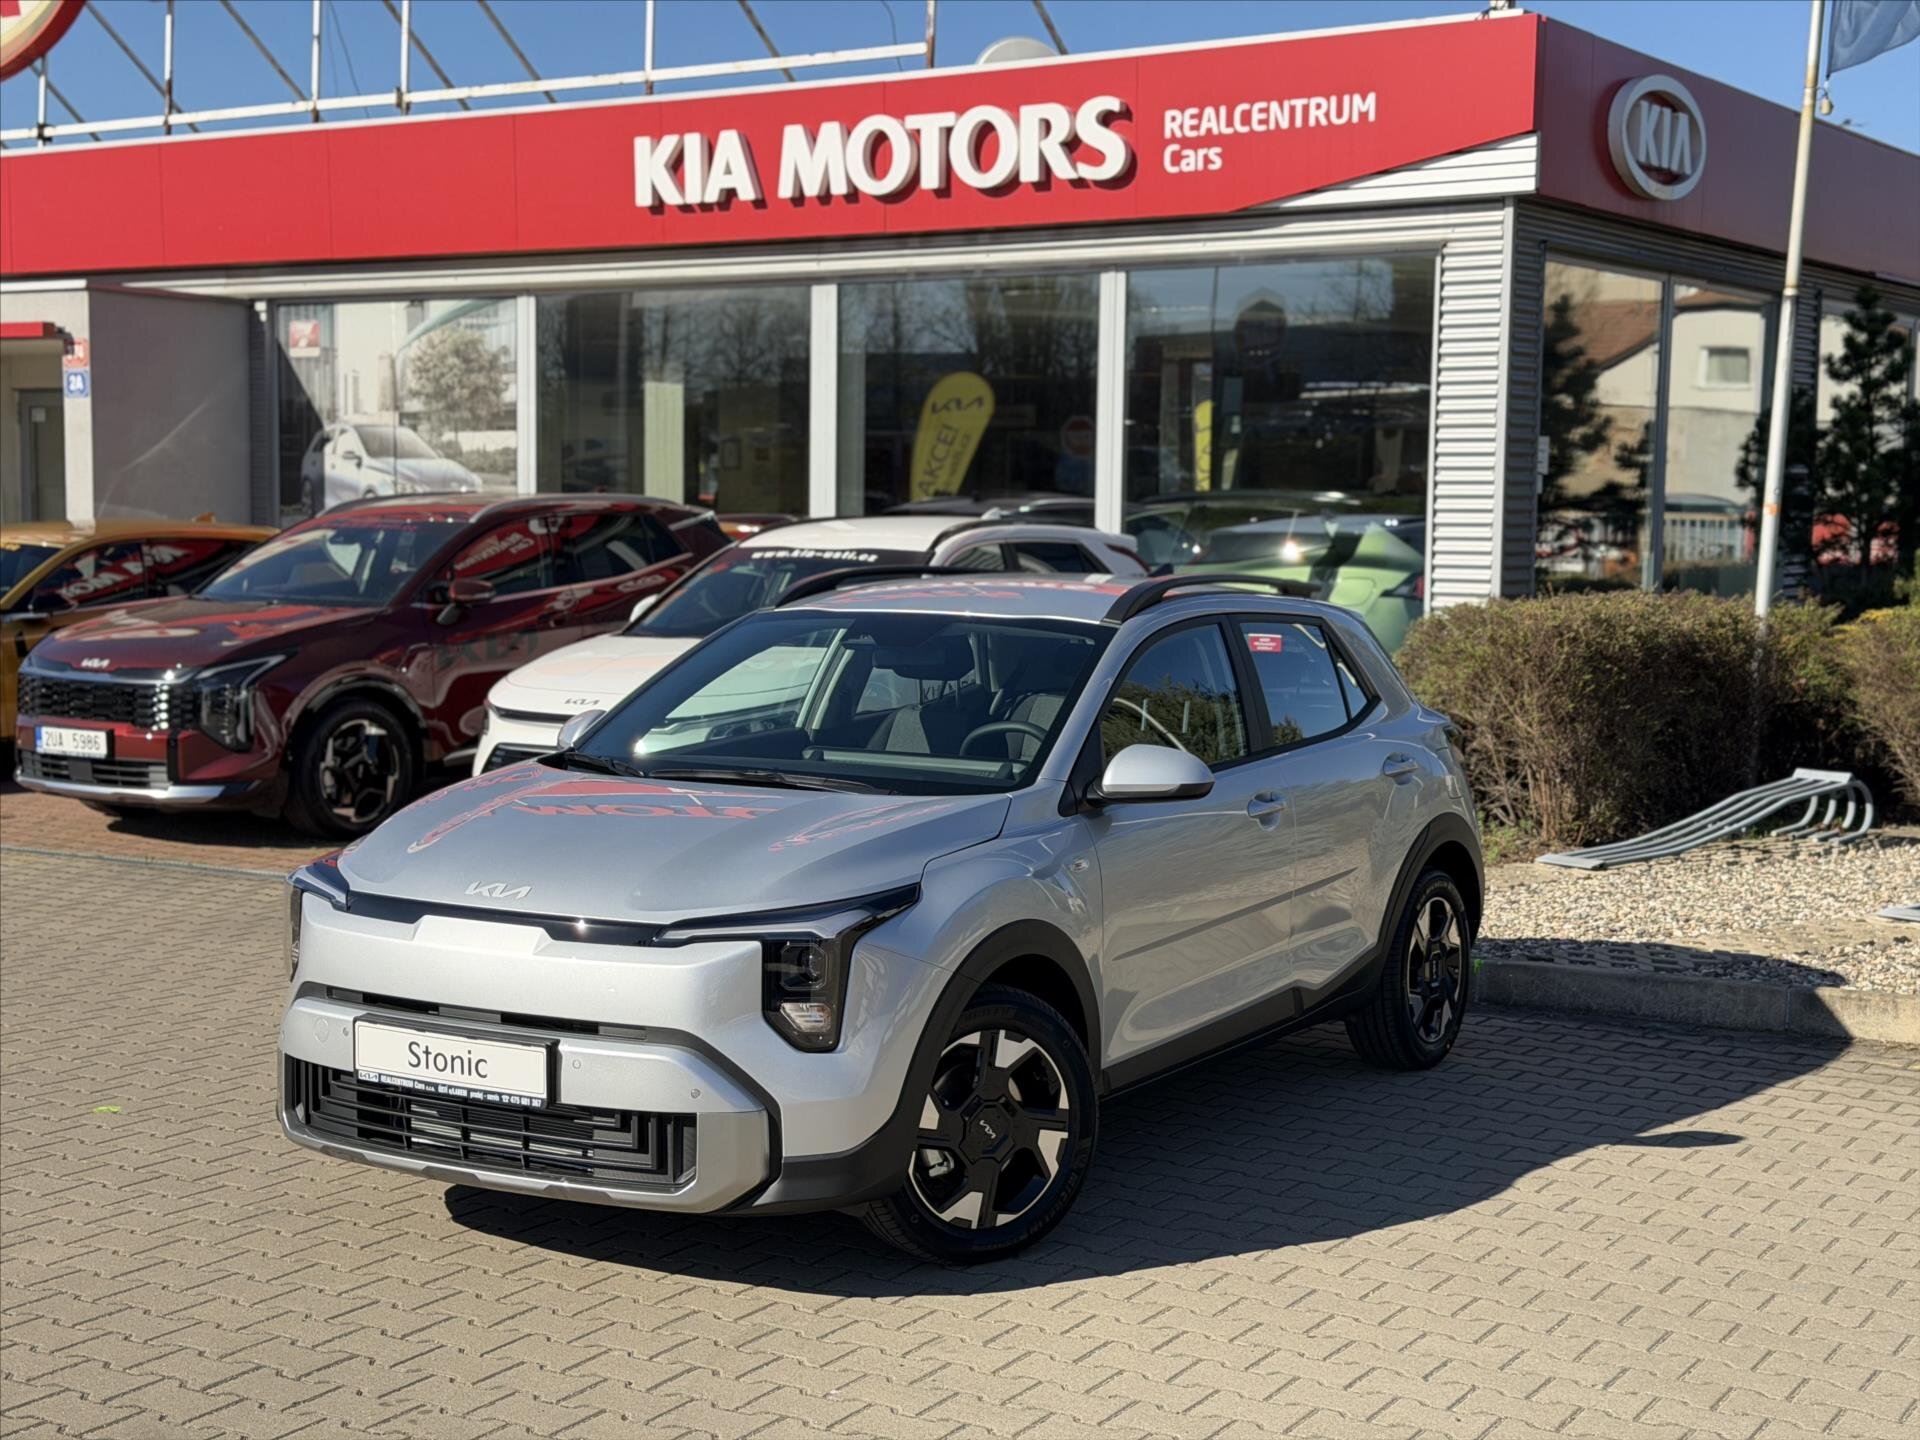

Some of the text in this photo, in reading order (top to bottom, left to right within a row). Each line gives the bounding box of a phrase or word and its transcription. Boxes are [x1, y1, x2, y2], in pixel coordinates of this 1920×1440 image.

[1164, 91, 1377, 140] REALCENTRUM
[1638, 99, 1692, 175] KIA
[633, 96, 1128, 208] KIA MOTORS
[1163, 143, 1223, 174] Cars
[71, 733, 101, 752] 5986
[408, 1041, 488, 1079] Stonic
